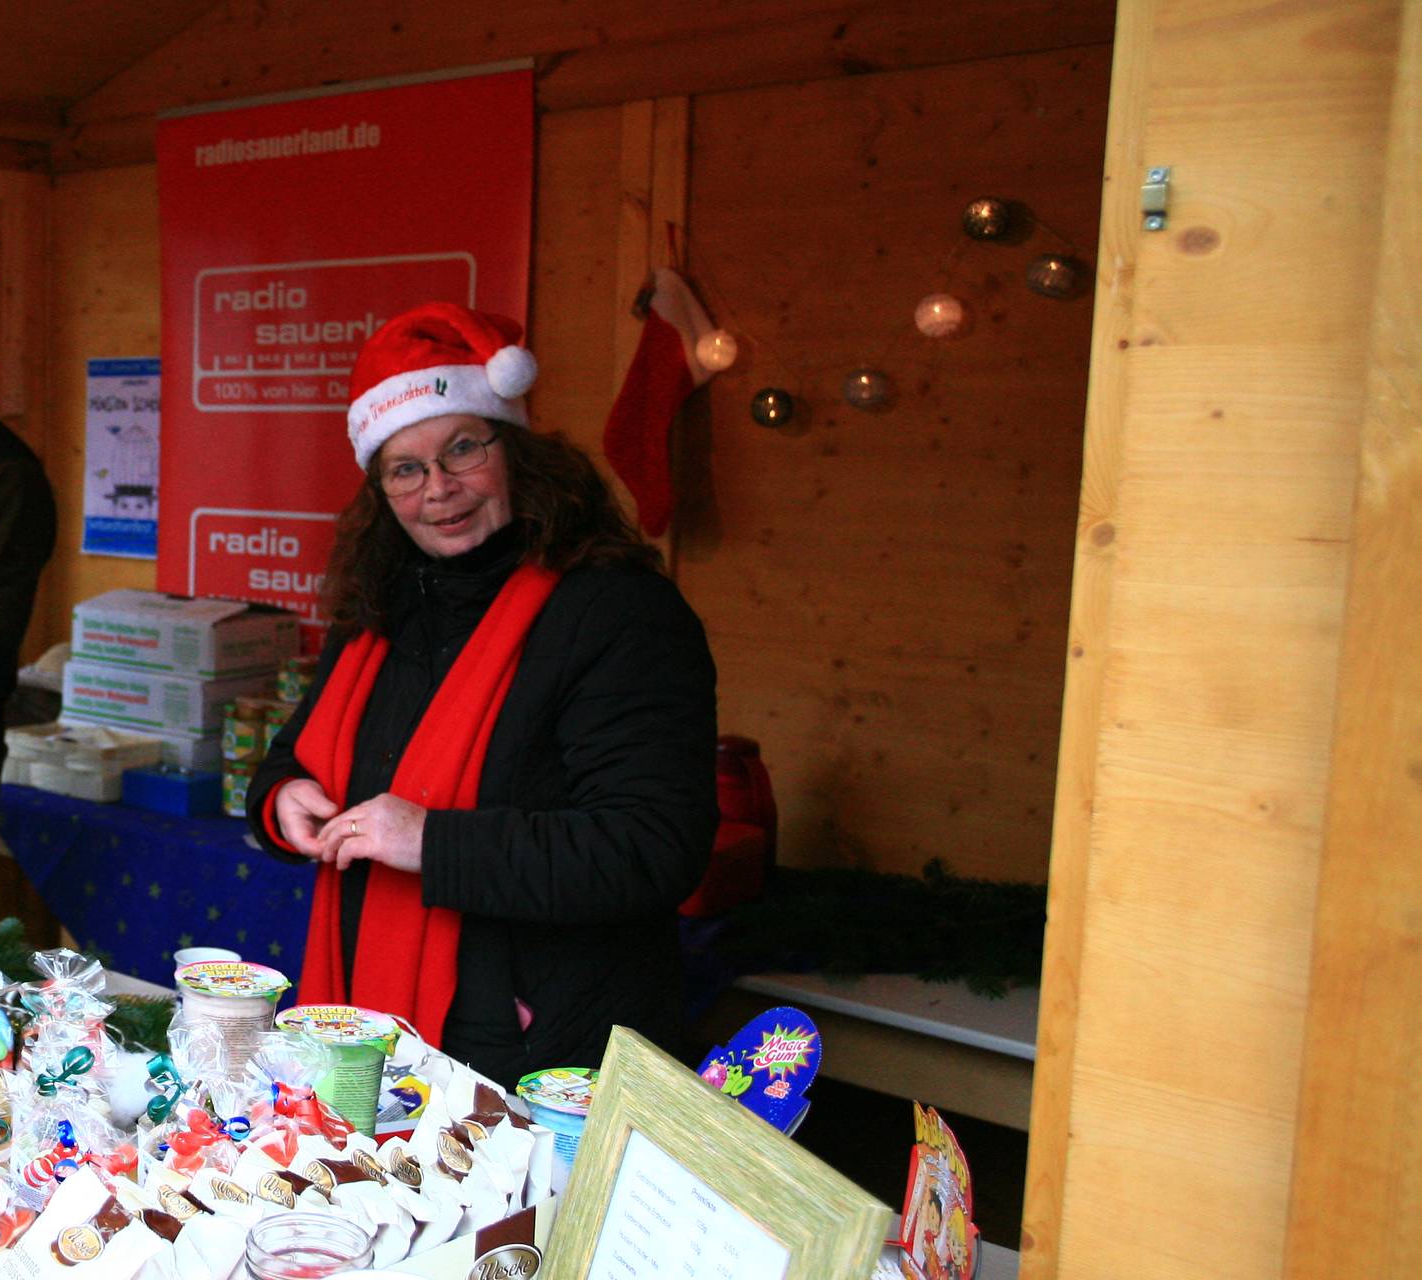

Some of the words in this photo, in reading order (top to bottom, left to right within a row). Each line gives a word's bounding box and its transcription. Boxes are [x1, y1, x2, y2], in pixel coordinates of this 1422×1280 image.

[195, 122, 382, 167] radiosauerland.de
[213, 282, 308, 312] radio
[261, 386, 288, 398] von
[209, 527, 300, 558] radio
[478, 1256, 532, 1280] Weseke
